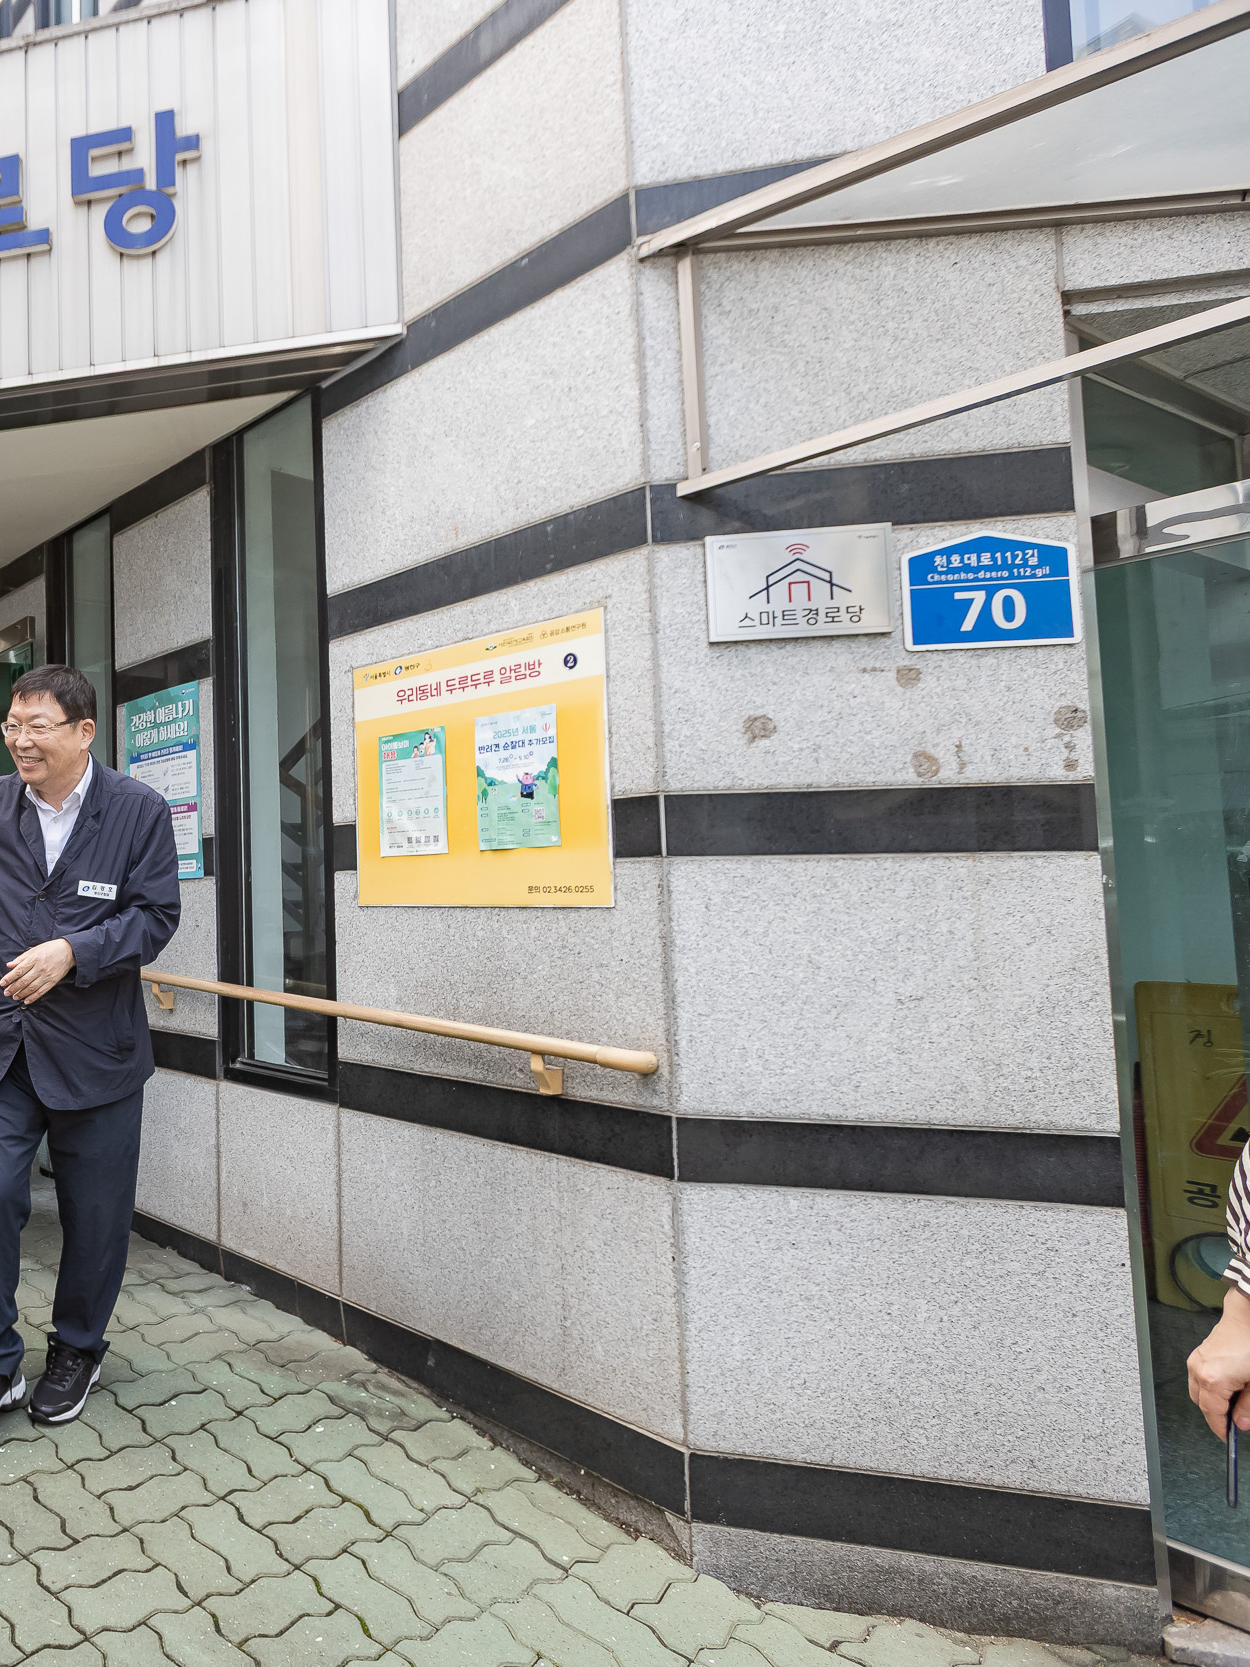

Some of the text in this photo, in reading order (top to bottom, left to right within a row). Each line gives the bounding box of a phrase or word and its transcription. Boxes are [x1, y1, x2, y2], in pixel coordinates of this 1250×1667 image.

[934, 549, 1039, 572] 천호대로112길
[927, 566, 1050, 582] Cheonho-daero 112-gil
[738, 604, 865, 629] 스마트경로당
[954, 588, 1027, 632] 70
[396, 658, 543, 706] 우리동네 두루두루 알림방
[130, 698, 194, 732] 건강한 여름나기
[136, 720, 188, 748] 이렇게 하세요!
[492, 724, 537, 740] 2025년 서울
[478, 736, 554, 754] 반려견 순찰대 추가모집
[528, 885, 594, 894] 문의 02.3426.0255
